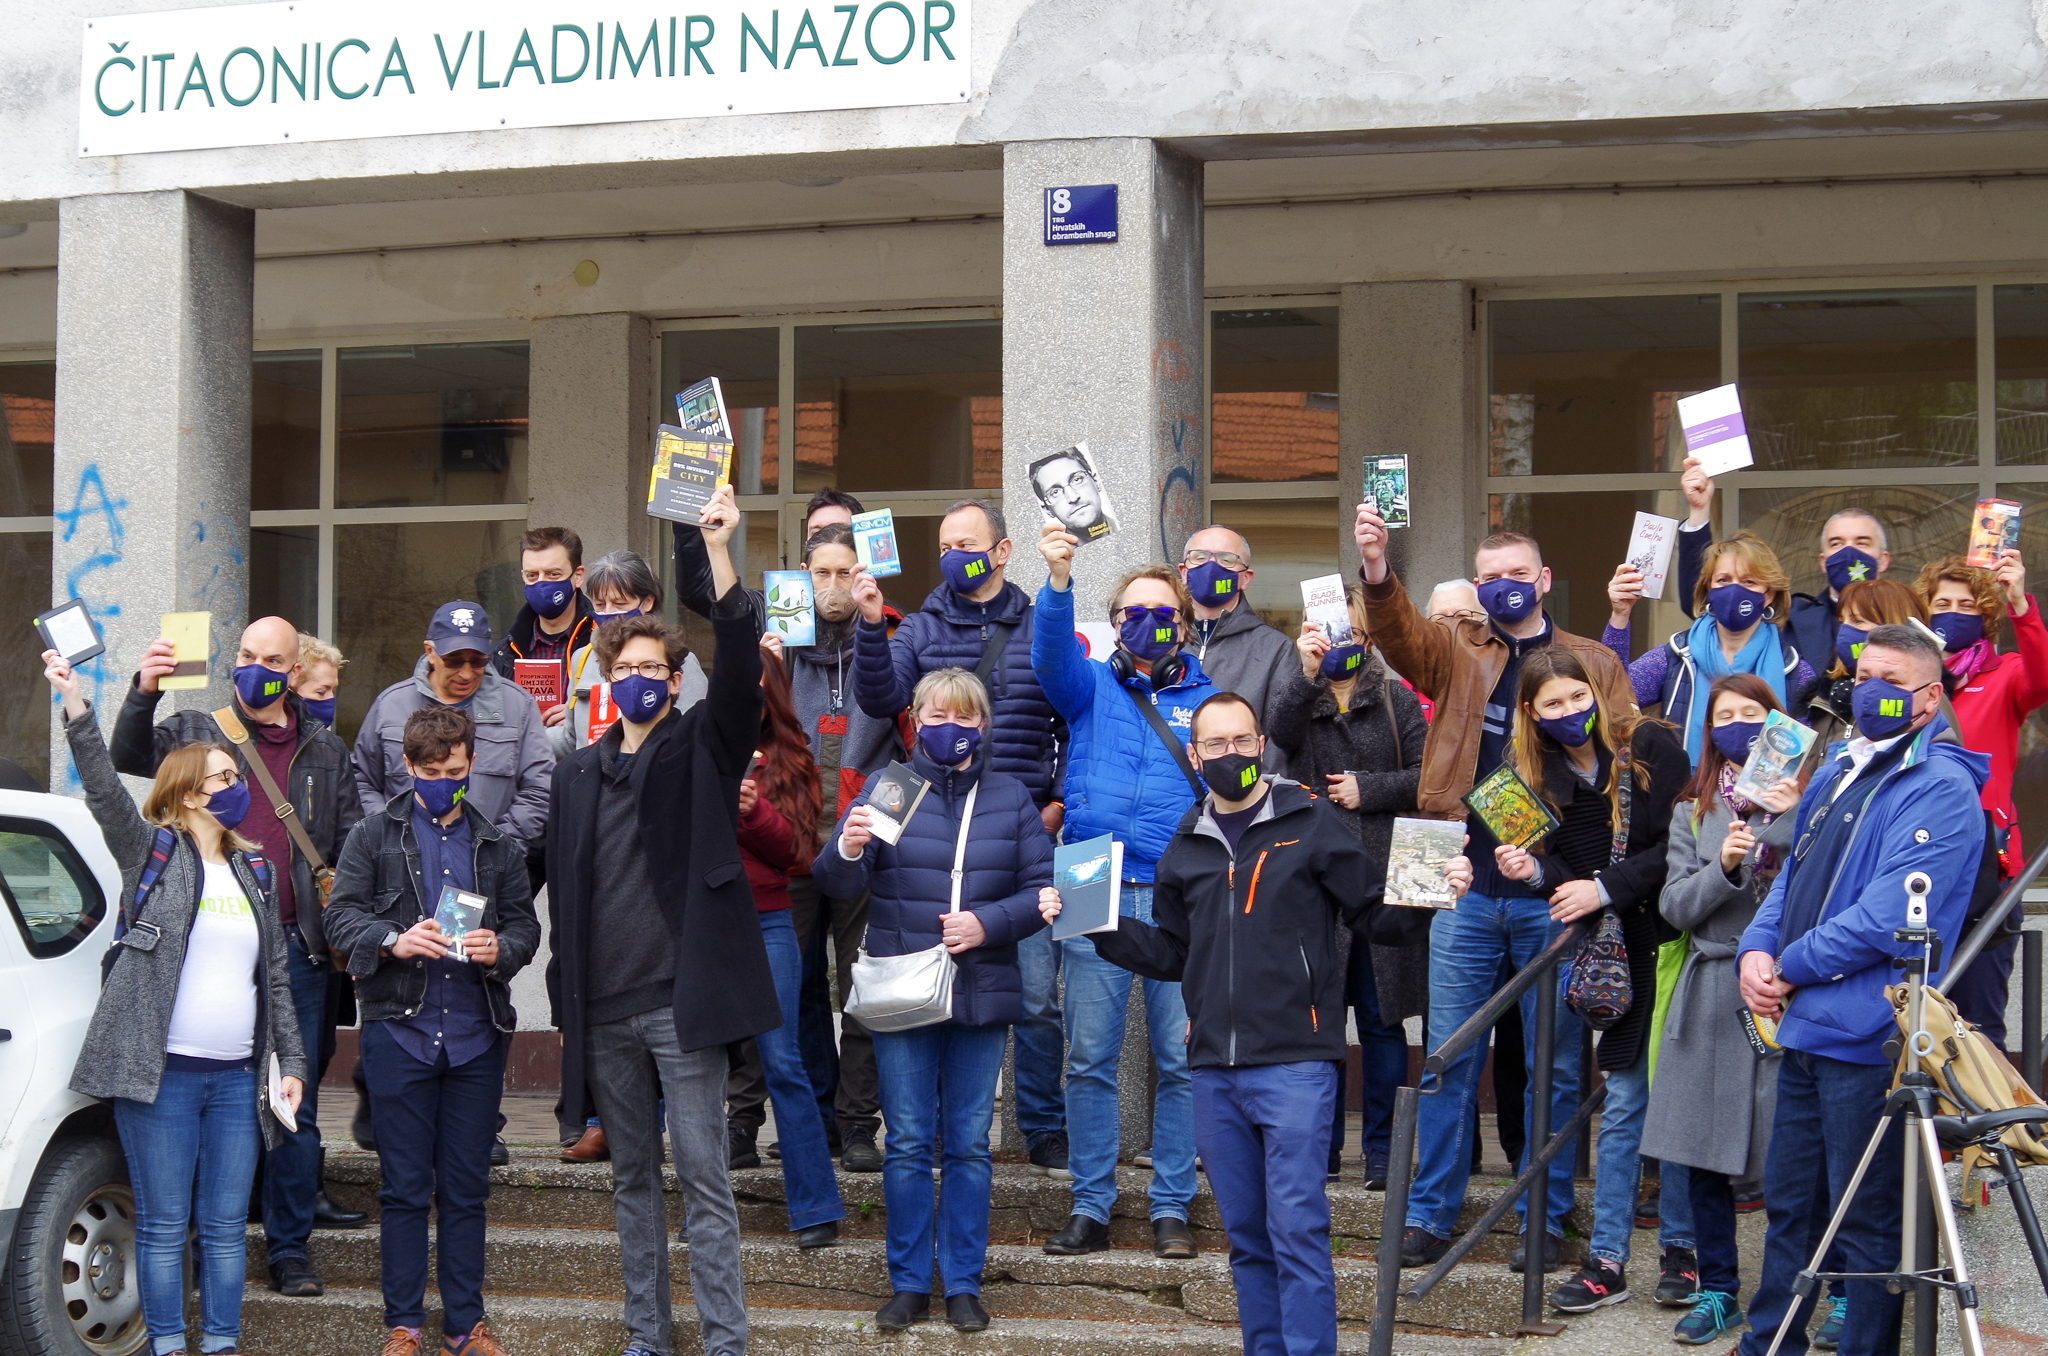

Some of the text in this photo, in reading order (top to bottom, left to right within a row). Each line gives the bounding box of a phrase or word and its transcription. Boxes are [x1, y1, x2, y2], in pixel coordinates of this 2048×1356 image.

[95, 0, 957, 117] ČITAONICA VLADIMIR NAZOR
[1052, 188, 1072, 214] 8
[1052, 222, 1086, 232] Hrvatskih
[1052, 230, 1116, 240] obrambenih snaga
[683, 392, 719, 431] 50
[680, 471, 706, 483] CITY
[686, 463, 715, 476] INVISIBLE
[854, 516, 890, 531] ASIMOV
[1643, 520, 1663, 531] Paulo
[1640, 529, 1663, 542] Coelho
[964, 559, 986, 578] M!
[1215, 579, 1232, 594] M!
[1305, 595, 1347, 608] RUNNER
[1310, 589, 1337, 601] BLADE
[1155, 628, 1172, 643] M!
[1850, 642, 1865, 660] M
[1346, 652, 1361, 670] M!
[264, 681, 282, 696] M!
[1879, 698, 1904, 717] M!
[1240, 764, 1258, 788] M!
[1742, 1010, 1766, 1054] Chevalier
[1745, 1025, 1756, 1047] Tracy
